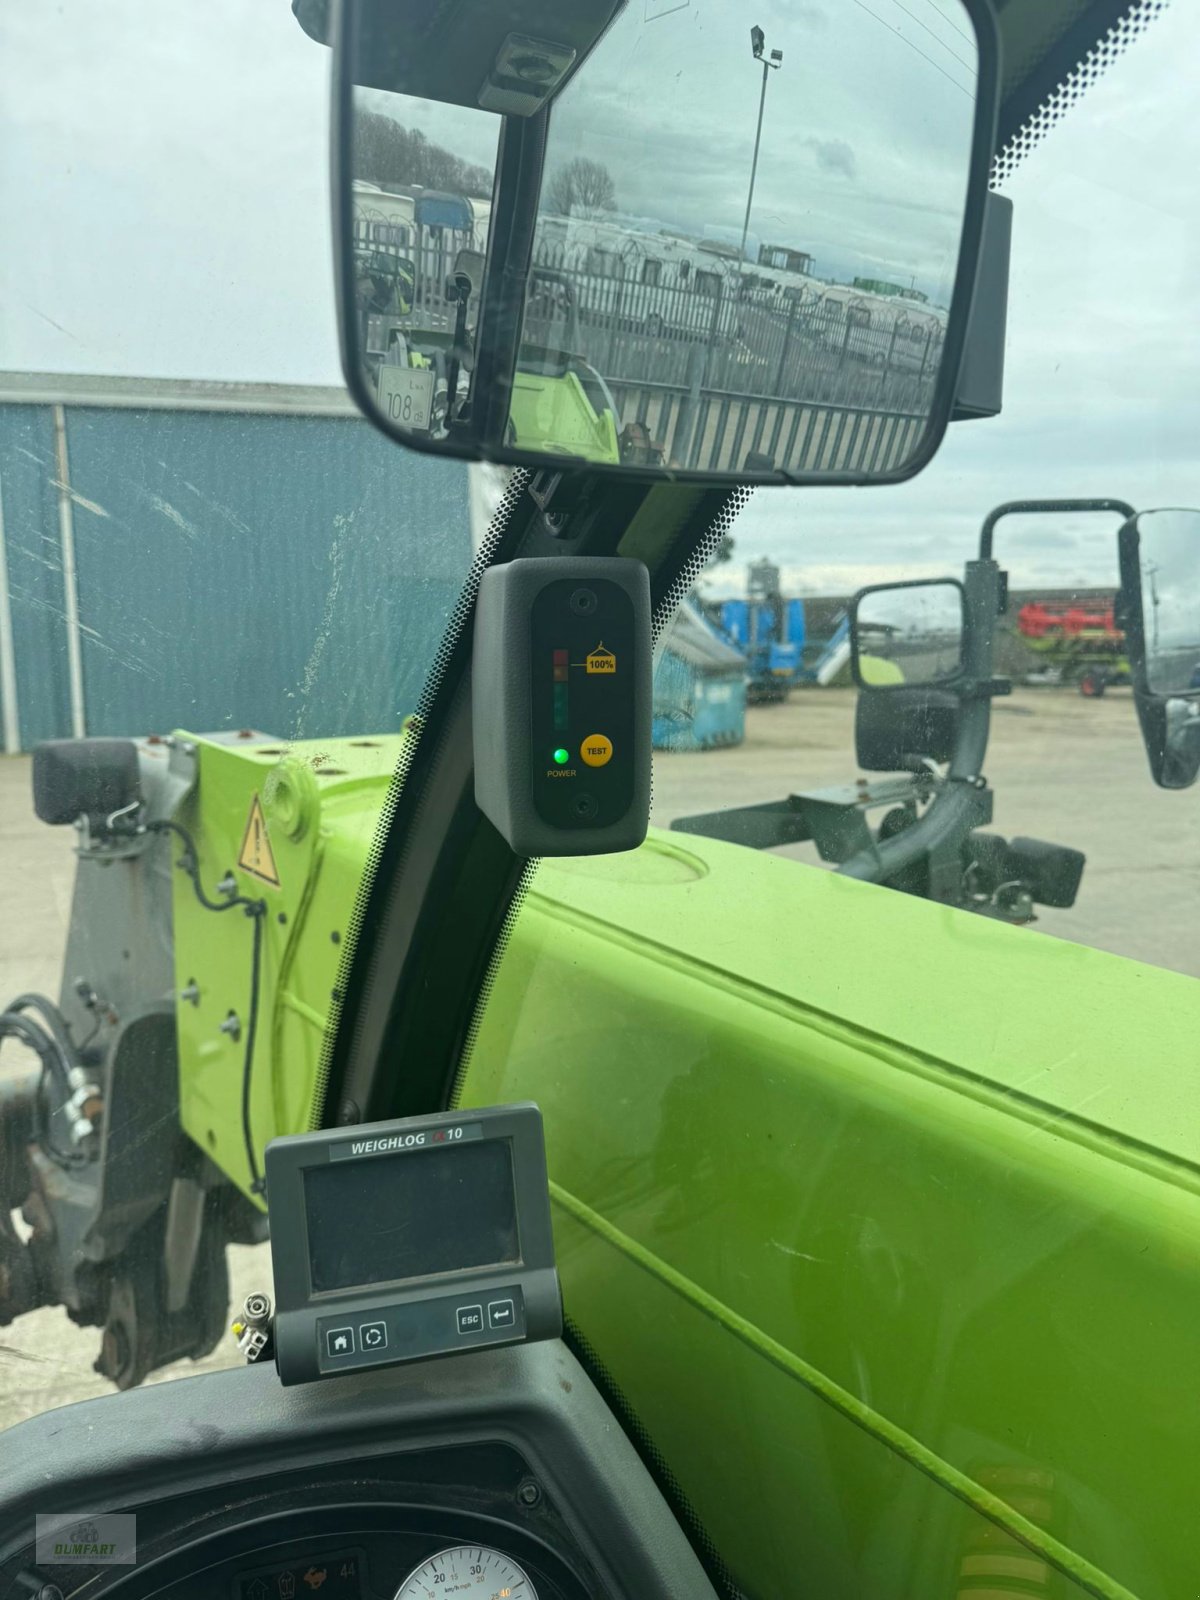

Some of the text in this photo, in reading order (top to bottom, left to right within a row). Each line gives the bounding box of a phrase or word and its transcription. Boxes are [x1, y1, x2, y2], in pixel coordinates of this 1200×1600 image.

[387, 392, 412, 421] 108
[589, 659, 614, 669] 100%
[587, 747, 607, 755] TEST
[351, 1133, 425, 1154] WEIGHLOG
[447, 1127, 463, 1140] 10
[461, 1315, 479, 1325] ESC
[470, 1564, 481, 1575] 30
[433, 1573, 446, 1584] 20
